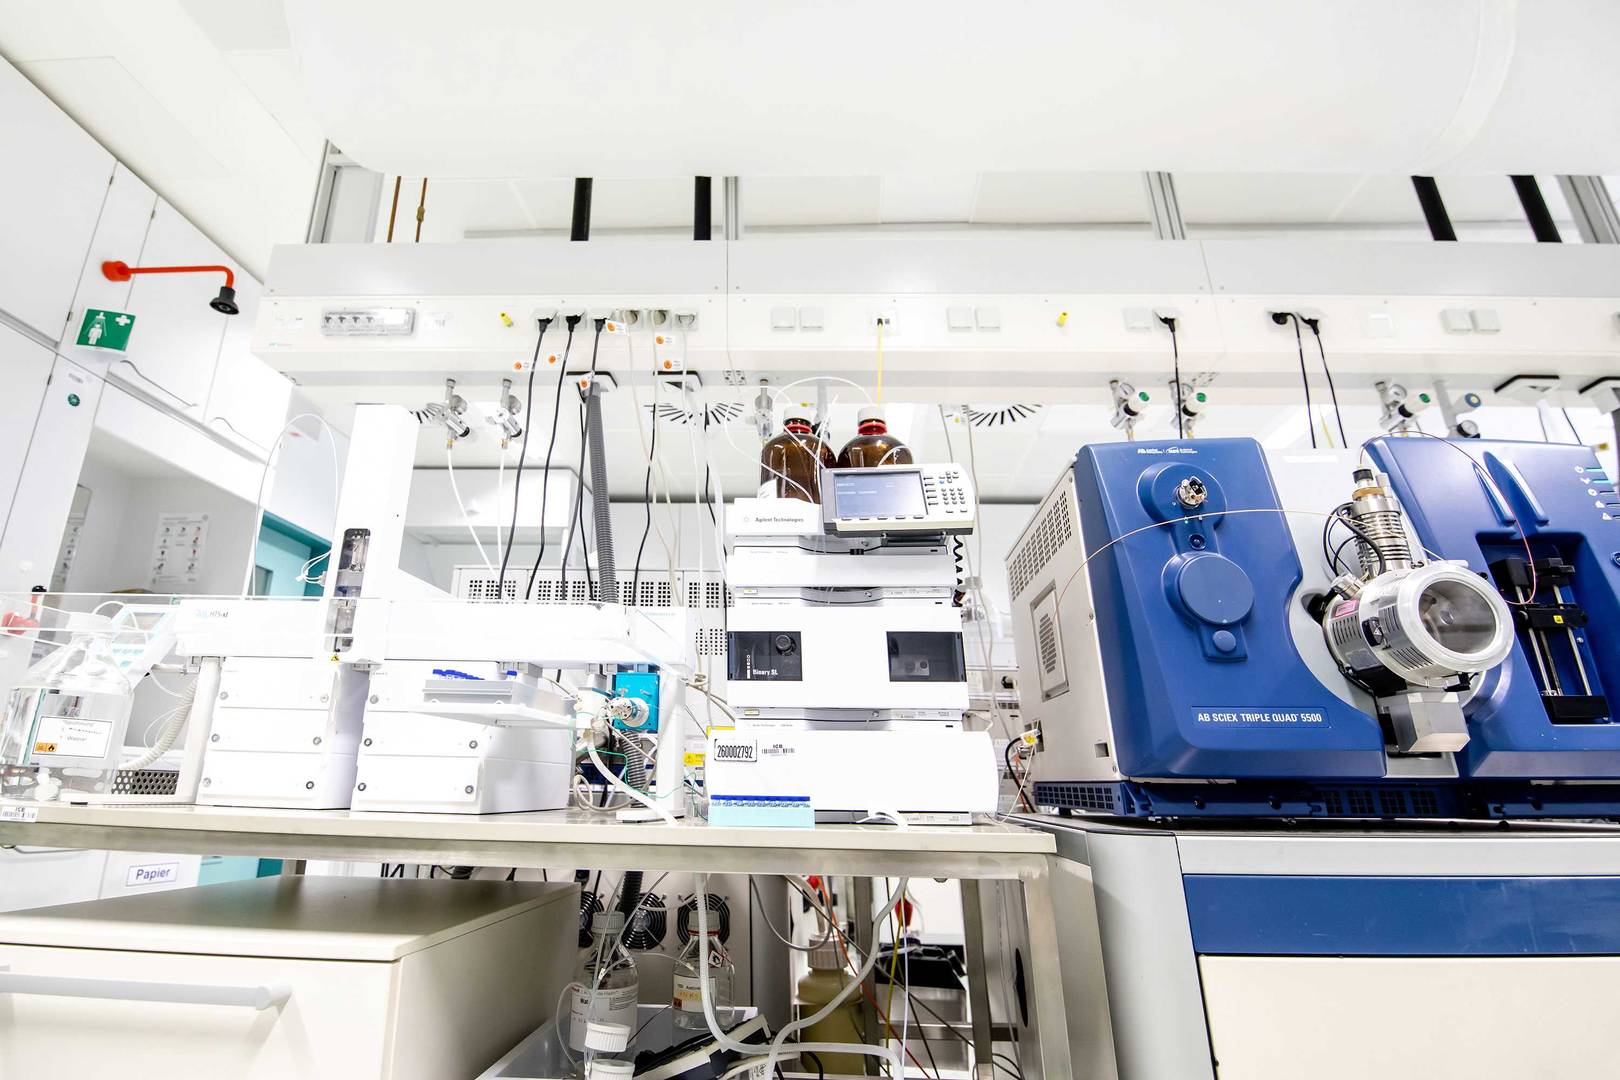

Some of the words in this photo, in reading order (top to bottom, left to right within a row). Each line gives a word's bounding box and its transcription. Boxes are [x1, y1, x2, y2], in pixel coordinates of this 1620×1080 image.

[1197, 713, 1210, 722] AB
[1212, 713, 1238, 722] SCIEX
[1240, 713, 1271, 722] TRIPLE
[1300, 713, 1323, 722] 5500
[717, 744, 753, 759] 260002792
[136, 868, 170, 881] Papier
